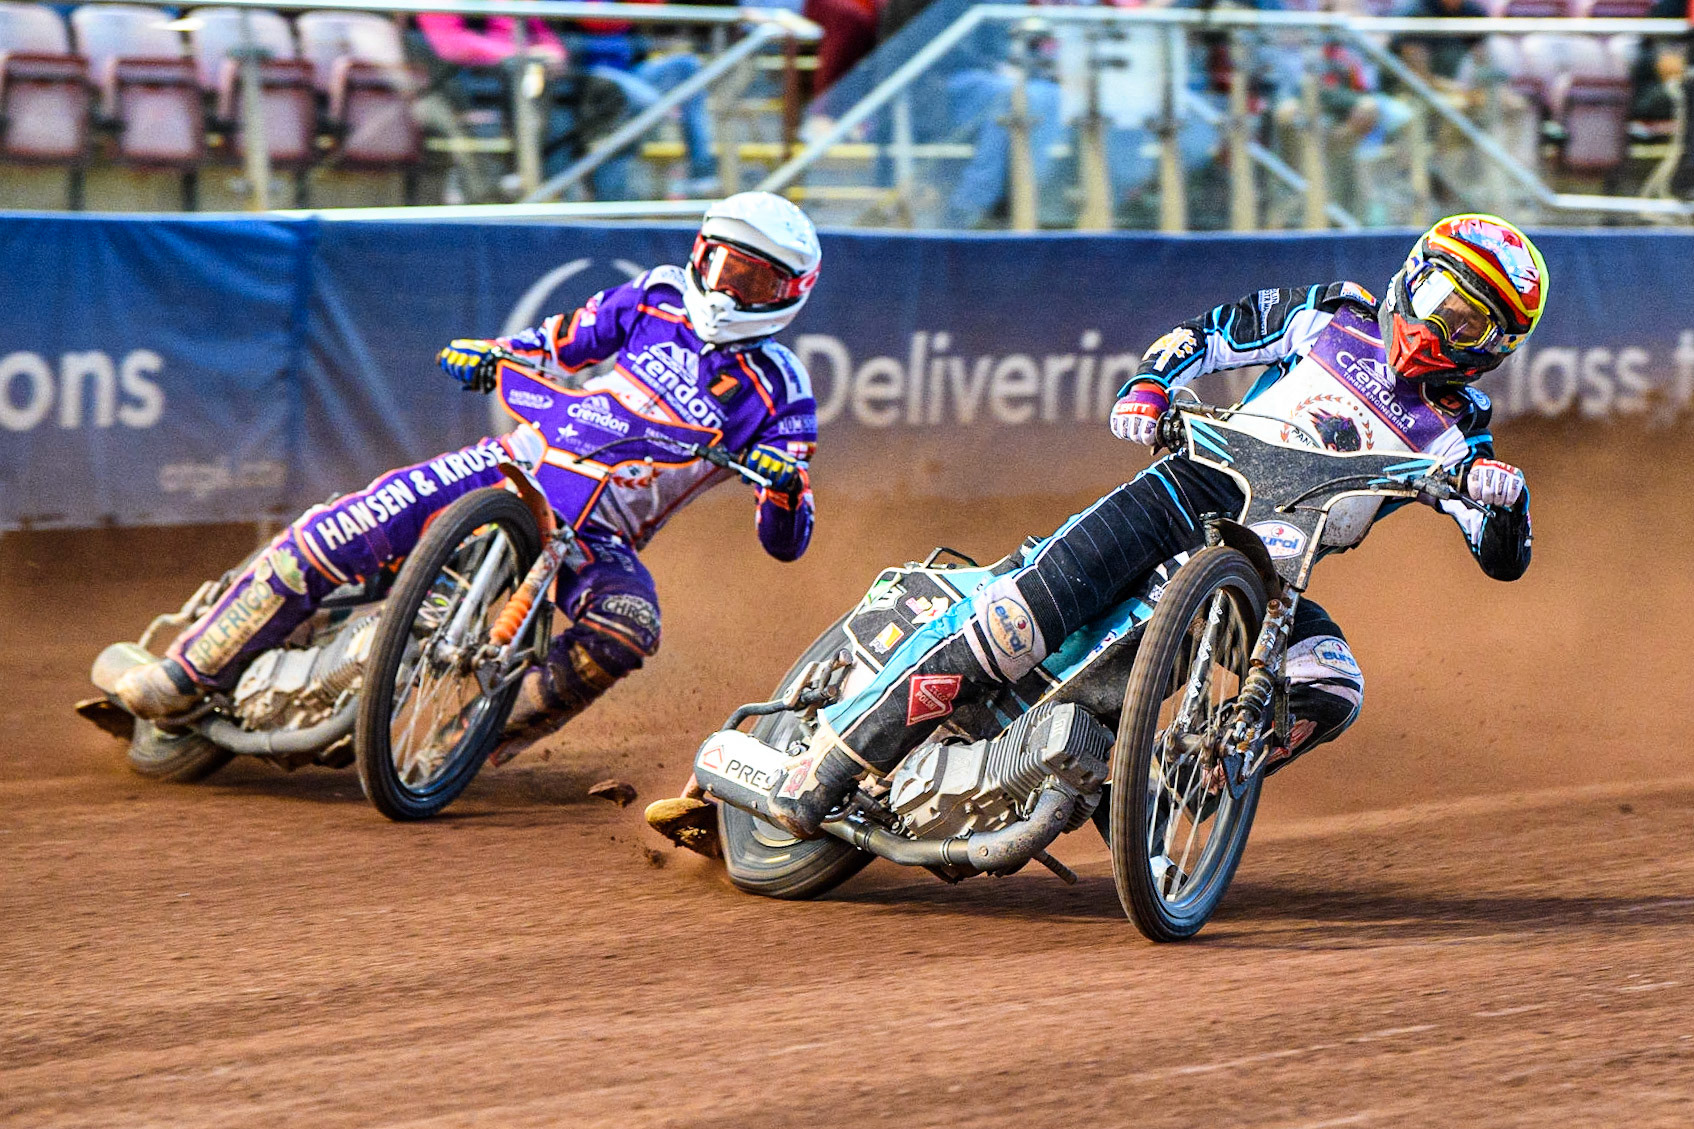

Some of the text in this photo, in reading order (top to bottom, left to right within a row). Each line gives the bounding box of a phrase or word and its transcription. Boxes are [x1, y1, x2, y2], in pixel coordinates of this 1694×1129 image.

[626, 345, 723, 430] rendon
[711, 373, 738, 397] 1
[796, 329, 1144, 427] Deliverin
[1508, 336, 1651, 418] lass
[1335, 350, 1416, 429] Crendon
[567, 402, 630, 435] Crendon
[1366, 392, 1409, 433] ENGINEERING
[316, 441, 510, 551] HANSEN & KRUSE
[1260, 535, 1300, 550] urol
